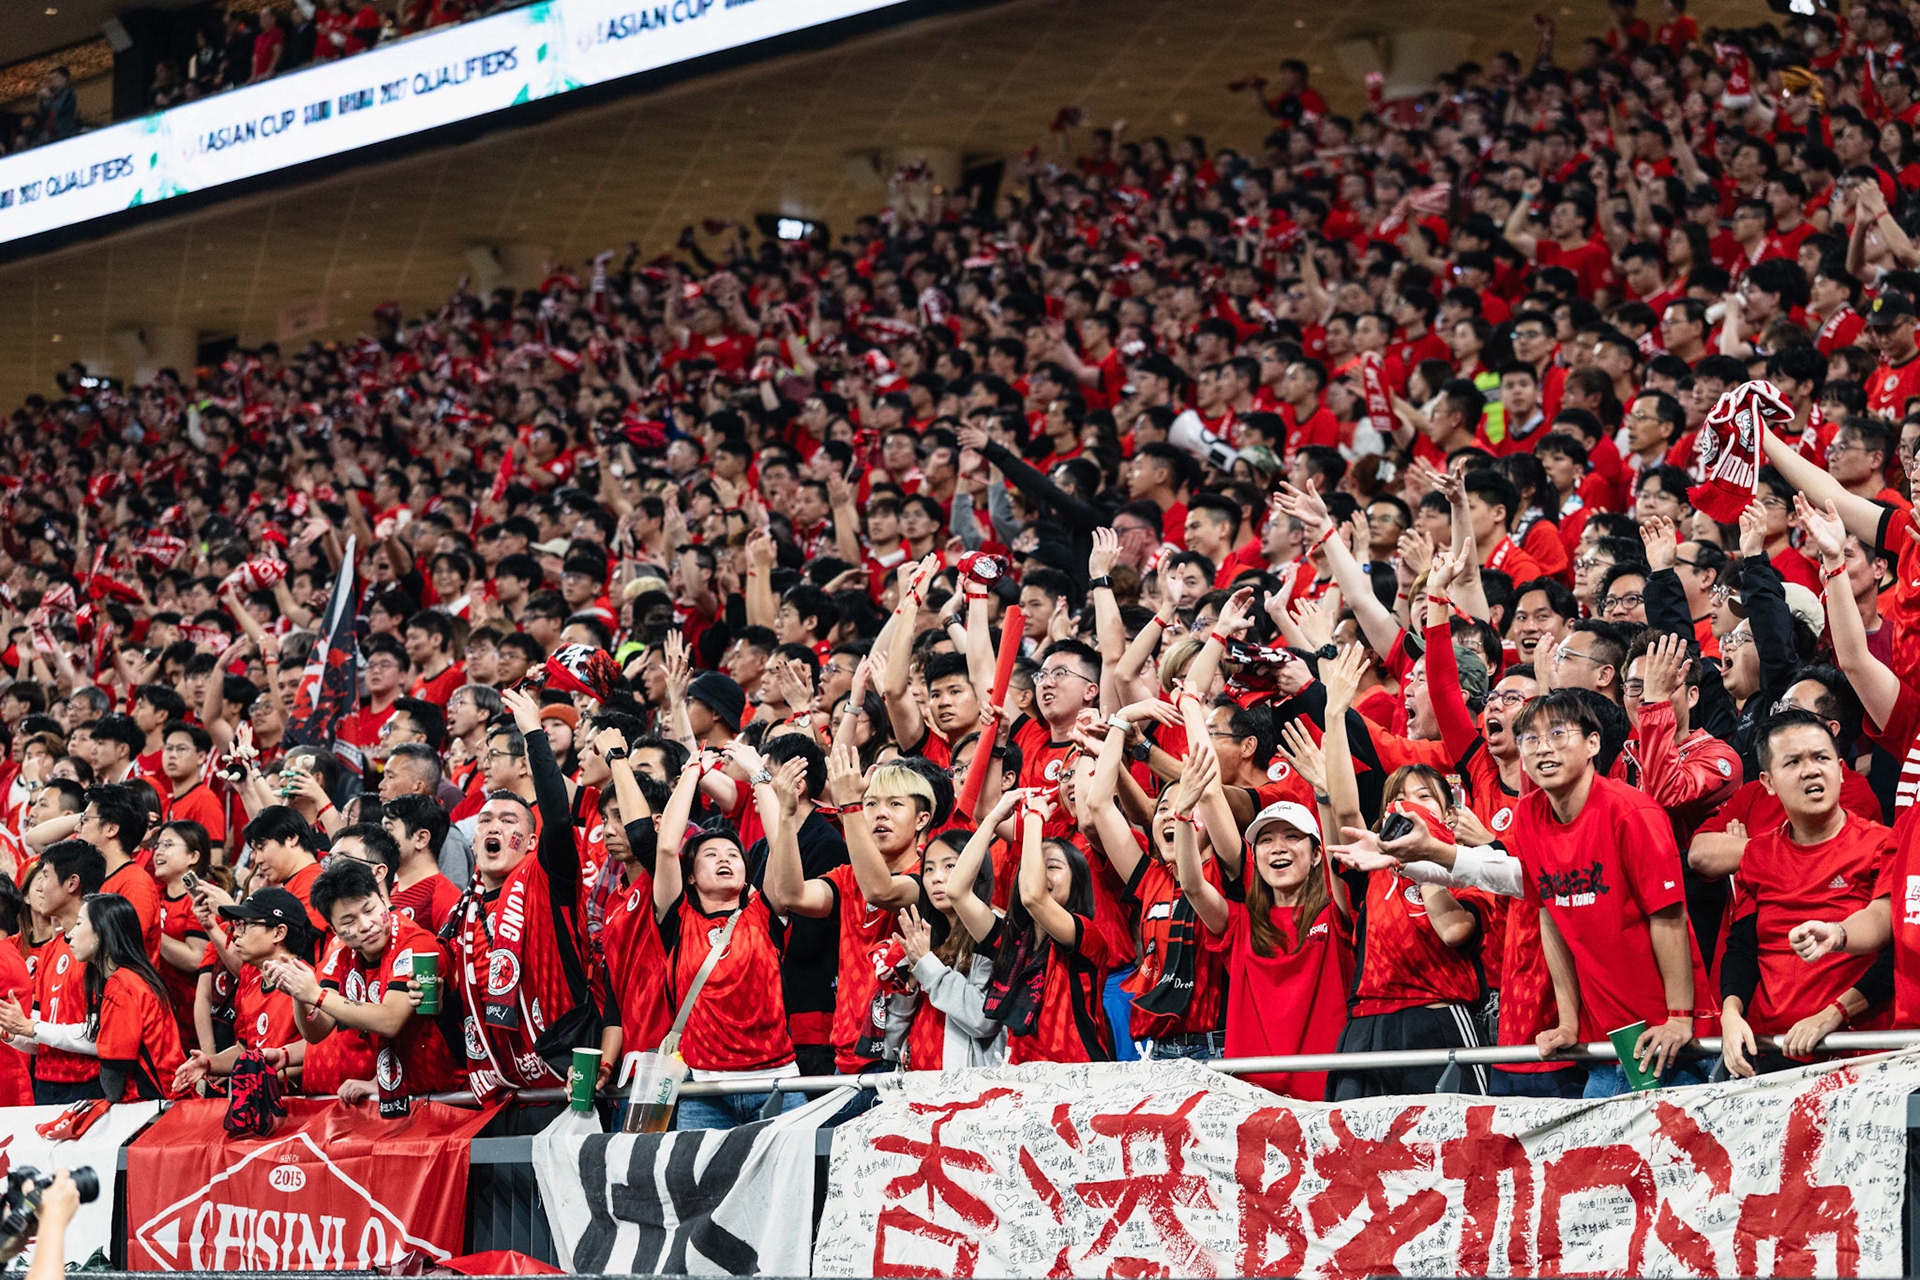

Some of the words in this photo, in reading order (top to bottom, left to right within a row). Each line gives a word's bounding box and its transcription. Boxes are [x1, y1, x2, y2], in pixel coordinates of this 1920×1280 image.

[206, 119, 257, 152] ASIAN
[260, 108, 295, 138] CUP
[413, 46, 518, 95] QUALIFIERS
[1572, 892, 1596, 907] KONG
[274, 1169, 302, 1187] 2015
[573, 1119, 774, 1276] HK
